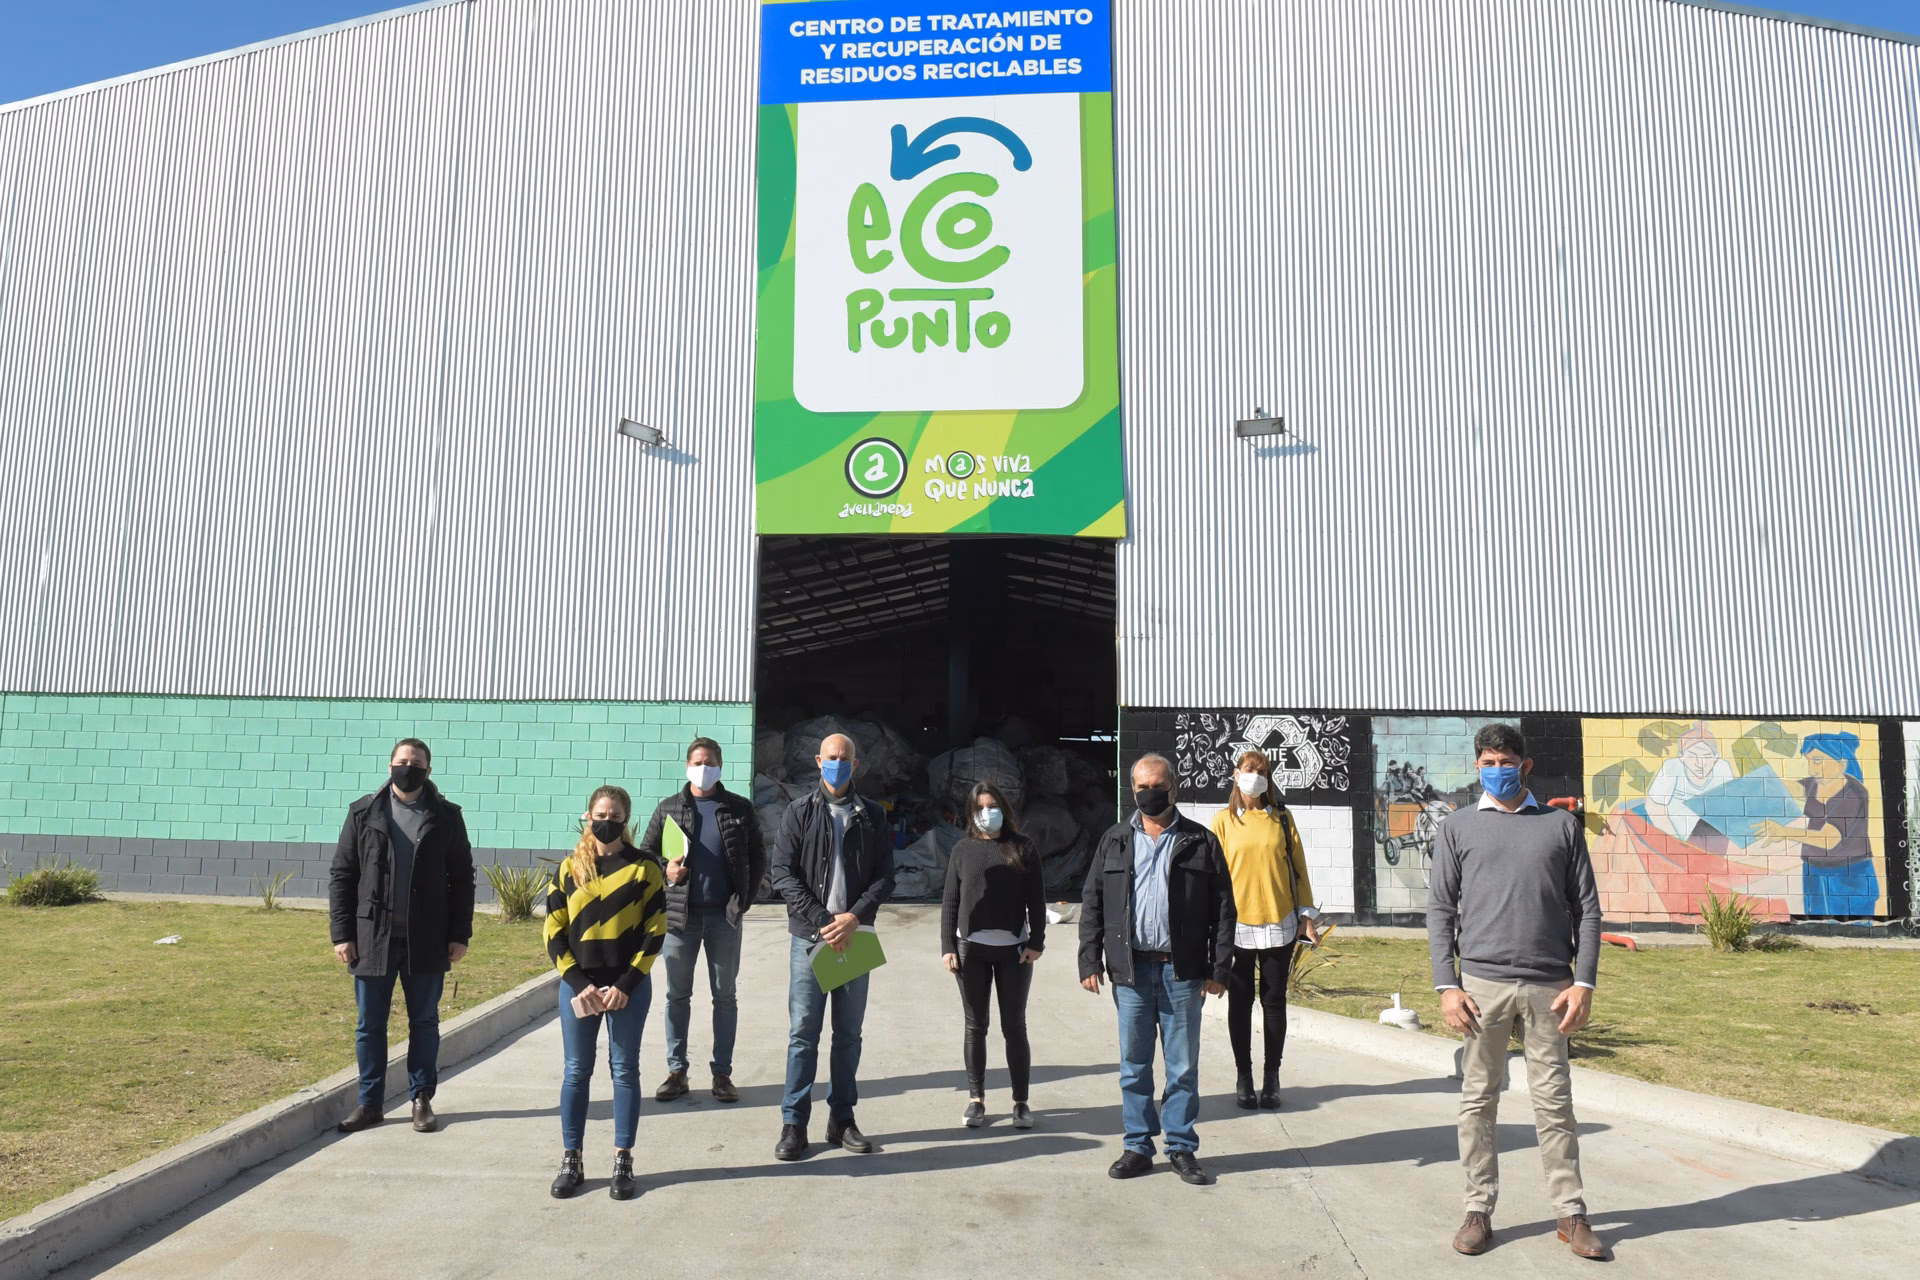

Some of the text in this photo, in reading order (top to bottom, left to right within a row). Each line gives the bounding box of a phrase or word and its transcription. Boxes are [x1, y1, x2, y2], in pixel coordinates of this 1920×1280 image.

[789, 8, 1093, 37] CENTRO DE TRATAMIENTO
[820, 33, 1062, 59] Y RECUPERACIÓN DE
[800, 57, 1082, 85] RESIDUOS RECICLABLES
[1261, 747, 1288, 762] MTE
